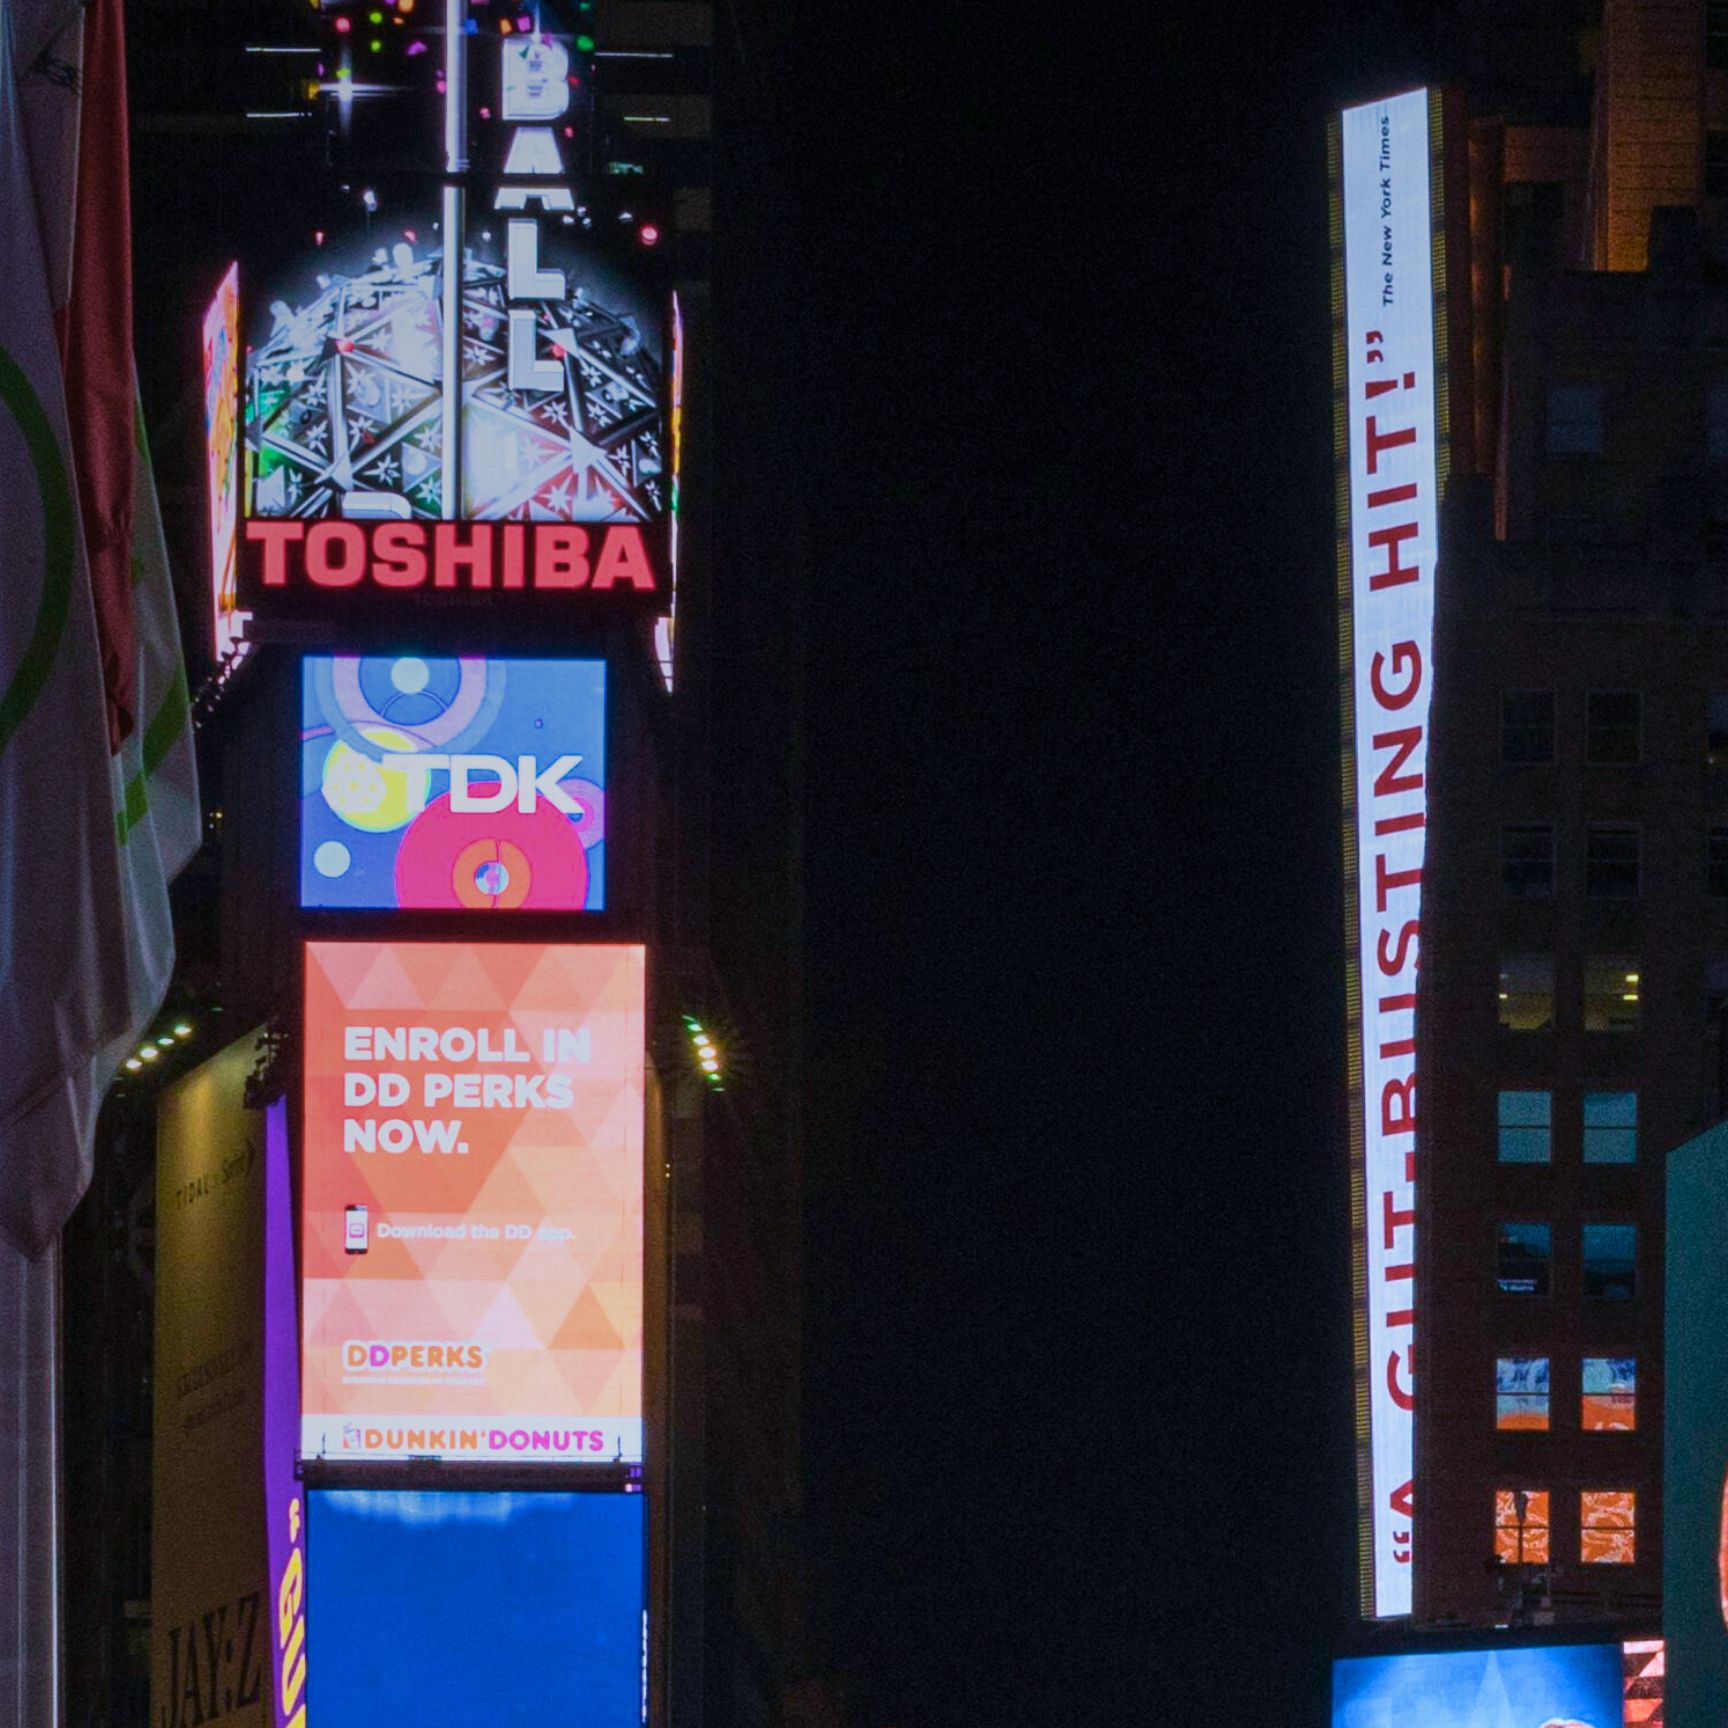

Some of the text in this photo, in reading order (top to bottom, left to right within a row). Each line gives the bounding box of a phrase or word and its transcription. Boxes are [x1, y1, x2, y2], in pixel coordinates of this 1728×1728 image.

[1379, 115, 1395, 307] The New York Times
[246, 521, 657, 590] TOSHIBA
[381, 754, 584, 814] TDK
[344, 1024, 591, 1064] ENROLL IN
[344, 1071, 574, 1111] DD PERKS
[344, 1118, 470, 1156] NOW.
[377, 1222, 467, 1240] Download
[472, 1223, 500, 1240] the
[488, 1429, 604, 1451] DONUTS
